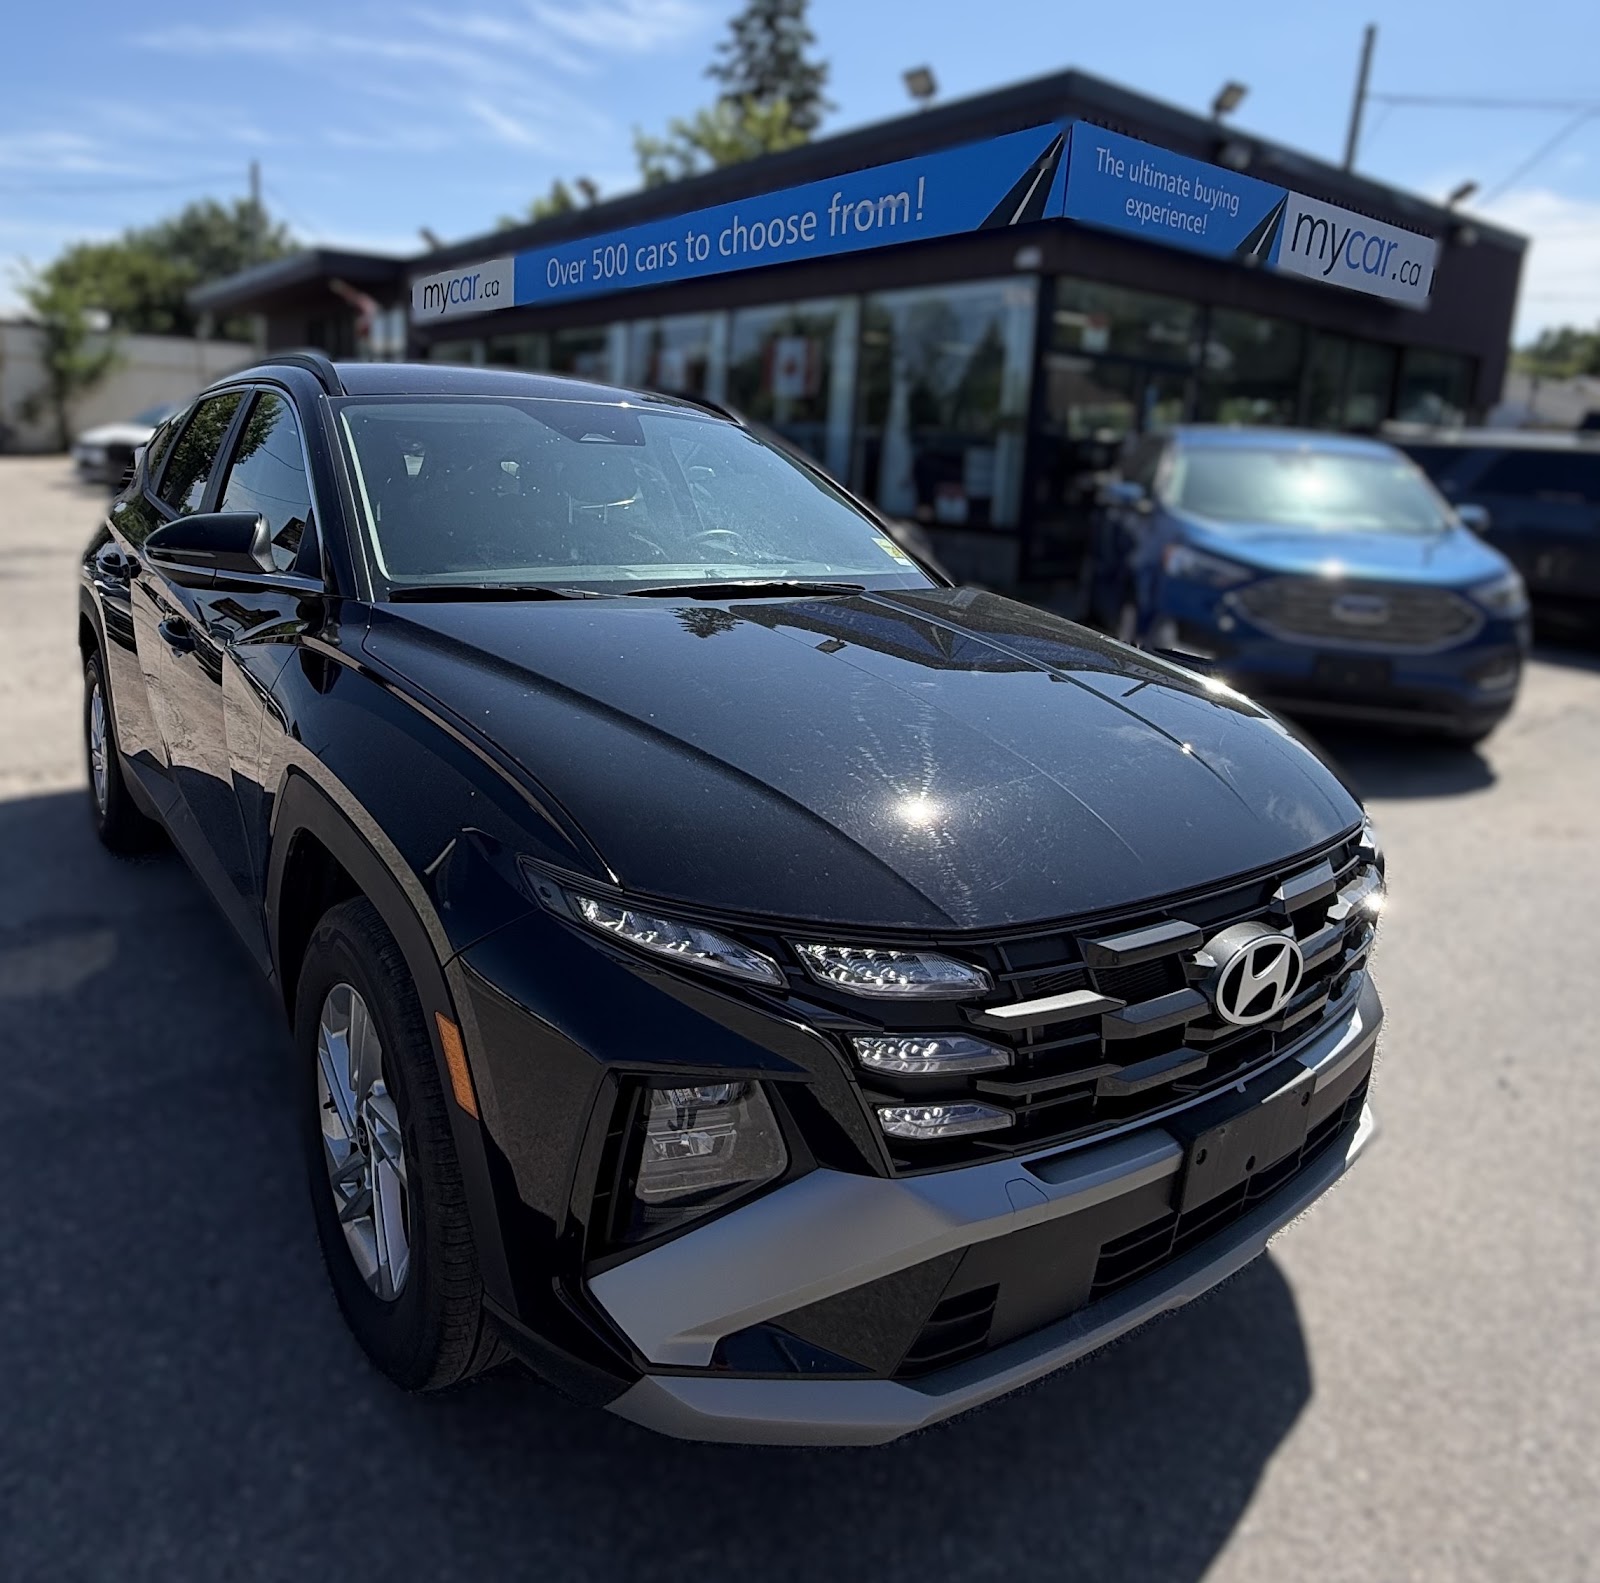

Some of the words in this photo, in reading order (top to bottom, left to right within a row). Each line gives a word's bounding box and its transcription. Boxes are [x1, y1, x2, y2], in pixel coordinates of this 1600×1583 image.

[1096, 147, 1125, 178] The
[1129, 159, 1191, 198] ultimate
[1194, 176, 1240, 217] buying
[1125, 198, 1208, 235] experience!
[547, 258, 586, 288] Over
[592, 243, 629, 280] 500
[635, 240, 678, 271] cars
[685, 230, 711, 263] to
[718, 212, 817, 257] choose
[828, 176, 926, 237] from!
[1290, 211, 1423, 287] mycar.ca
[423, 273, 500, 313] mycar.ca
